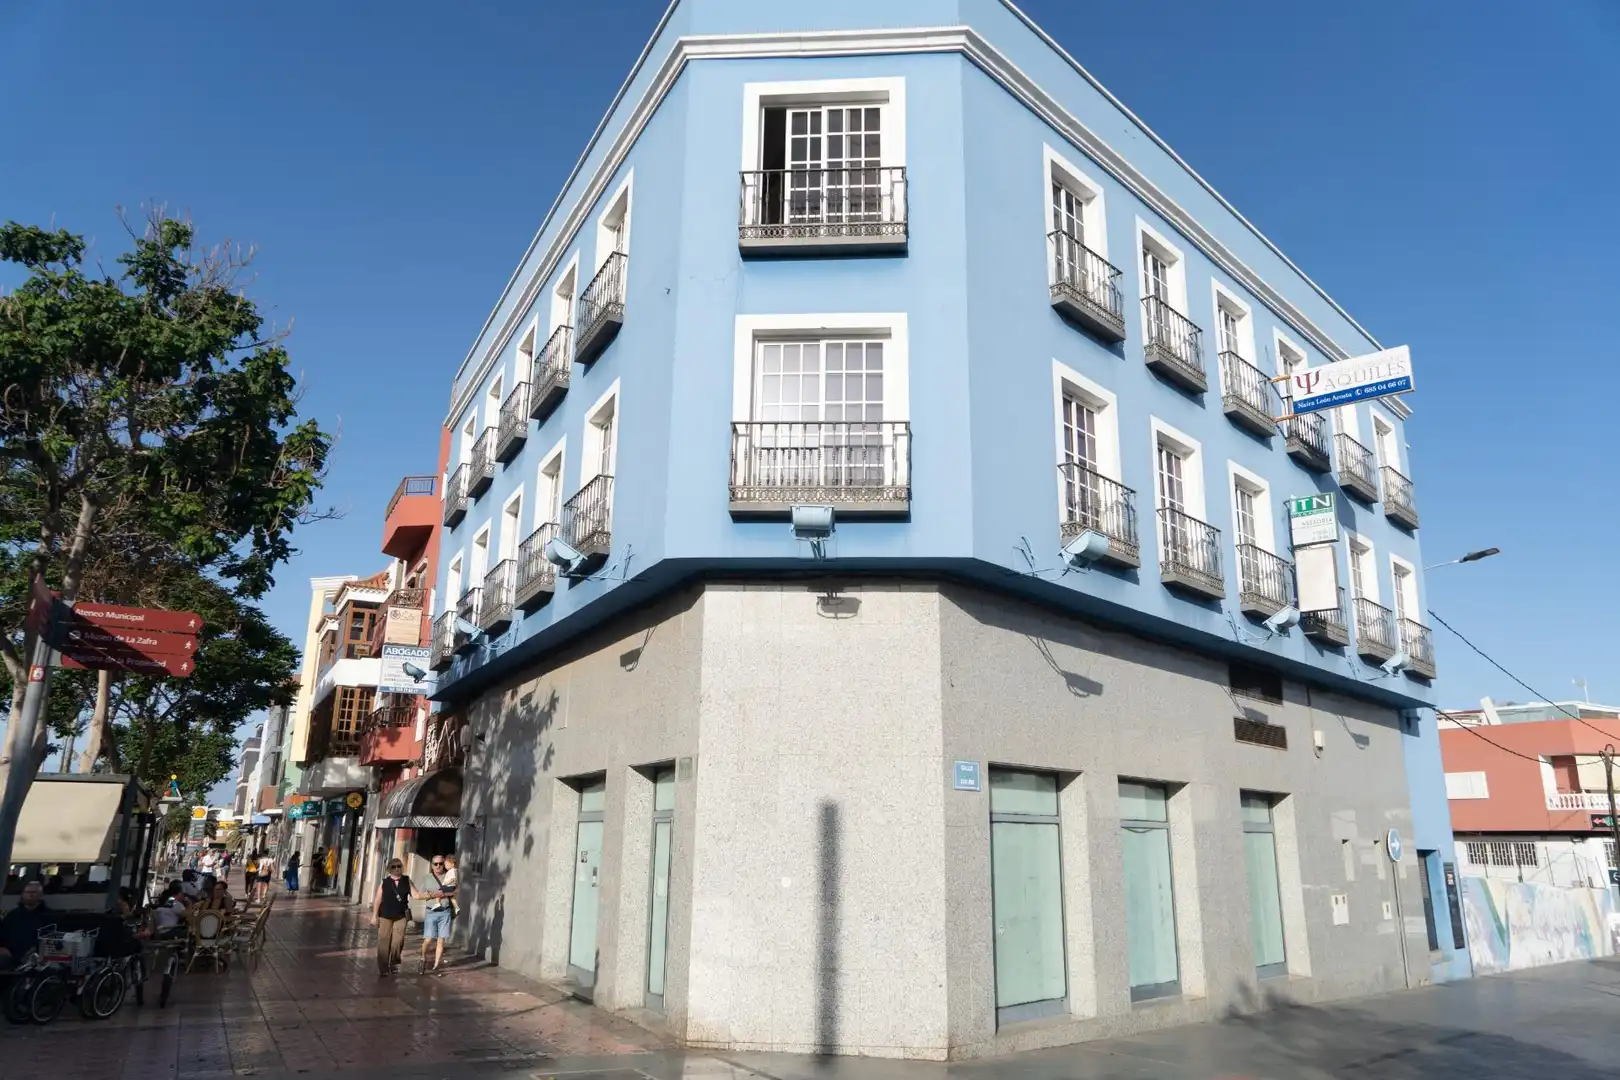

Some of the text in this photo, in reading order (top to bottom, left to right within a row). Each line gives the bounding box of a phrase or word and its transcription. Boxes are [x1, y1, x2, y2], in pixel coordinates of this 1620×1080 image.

[75, 608, 145, 622] Ateneo Municipal
[114, 634, 125, 642] de
[125, 635, 136, 644] La
[136, 637, 158, 646] Zafra
[385, 647, 429, 657] ABOGADO
